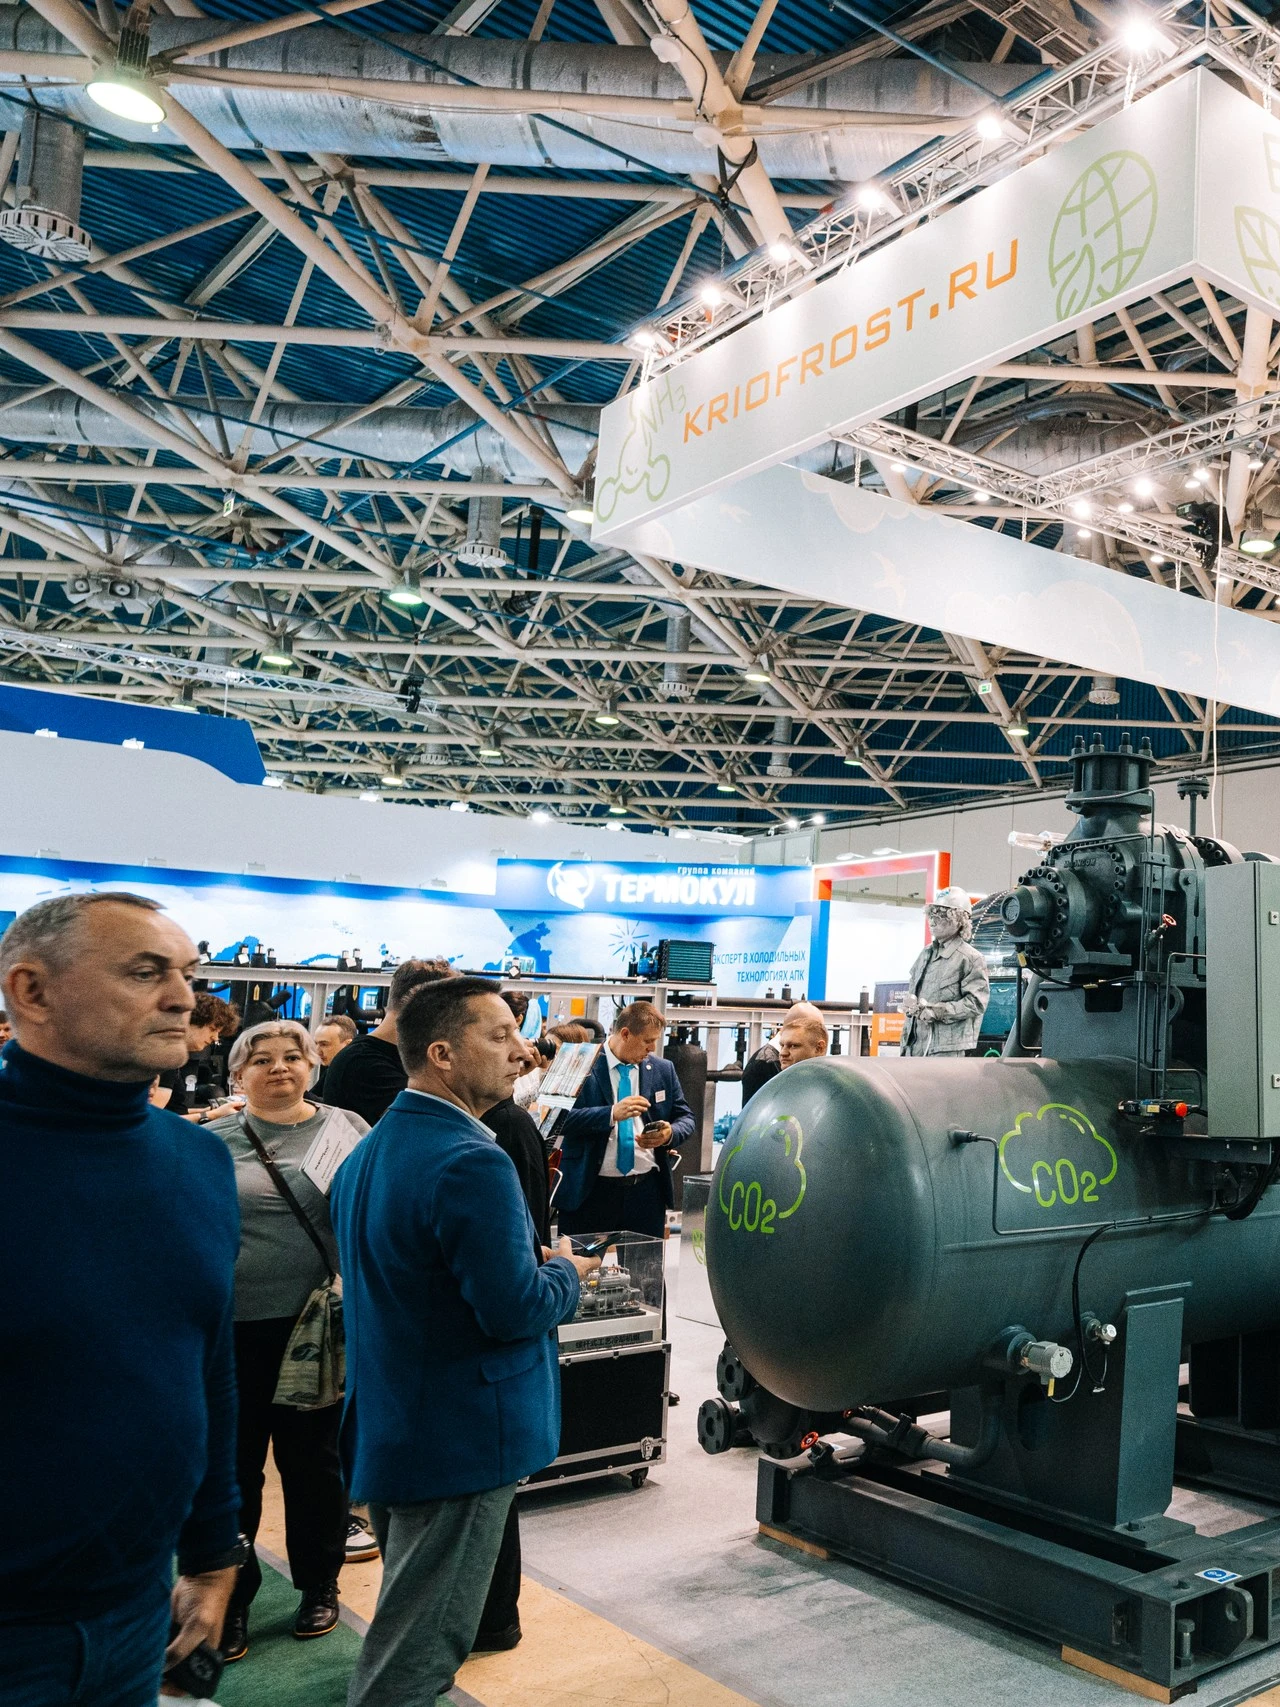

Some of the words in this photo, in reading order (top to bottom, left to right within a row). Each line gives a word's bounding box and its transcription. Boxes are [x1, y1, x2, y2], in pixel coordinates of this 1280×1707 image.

[683, 239, 1018, 444] KRIOFROST.RU
[677, 866, 709, 876] группа
[711, 867, 756, 876] компаний
[602, 874, 756, 906] ТЕРМОКУЛ
[712, 953, 742, 965] ЭКСПЕРТ
[743, 952, 748, 964] В
[749, 950, 806, 964] ХОЛОДИЛЬНЫХ
[737, 970, 788, 982] ТЕХНОЛОГИЯХ
[789, 970, 805, 981] АПК
